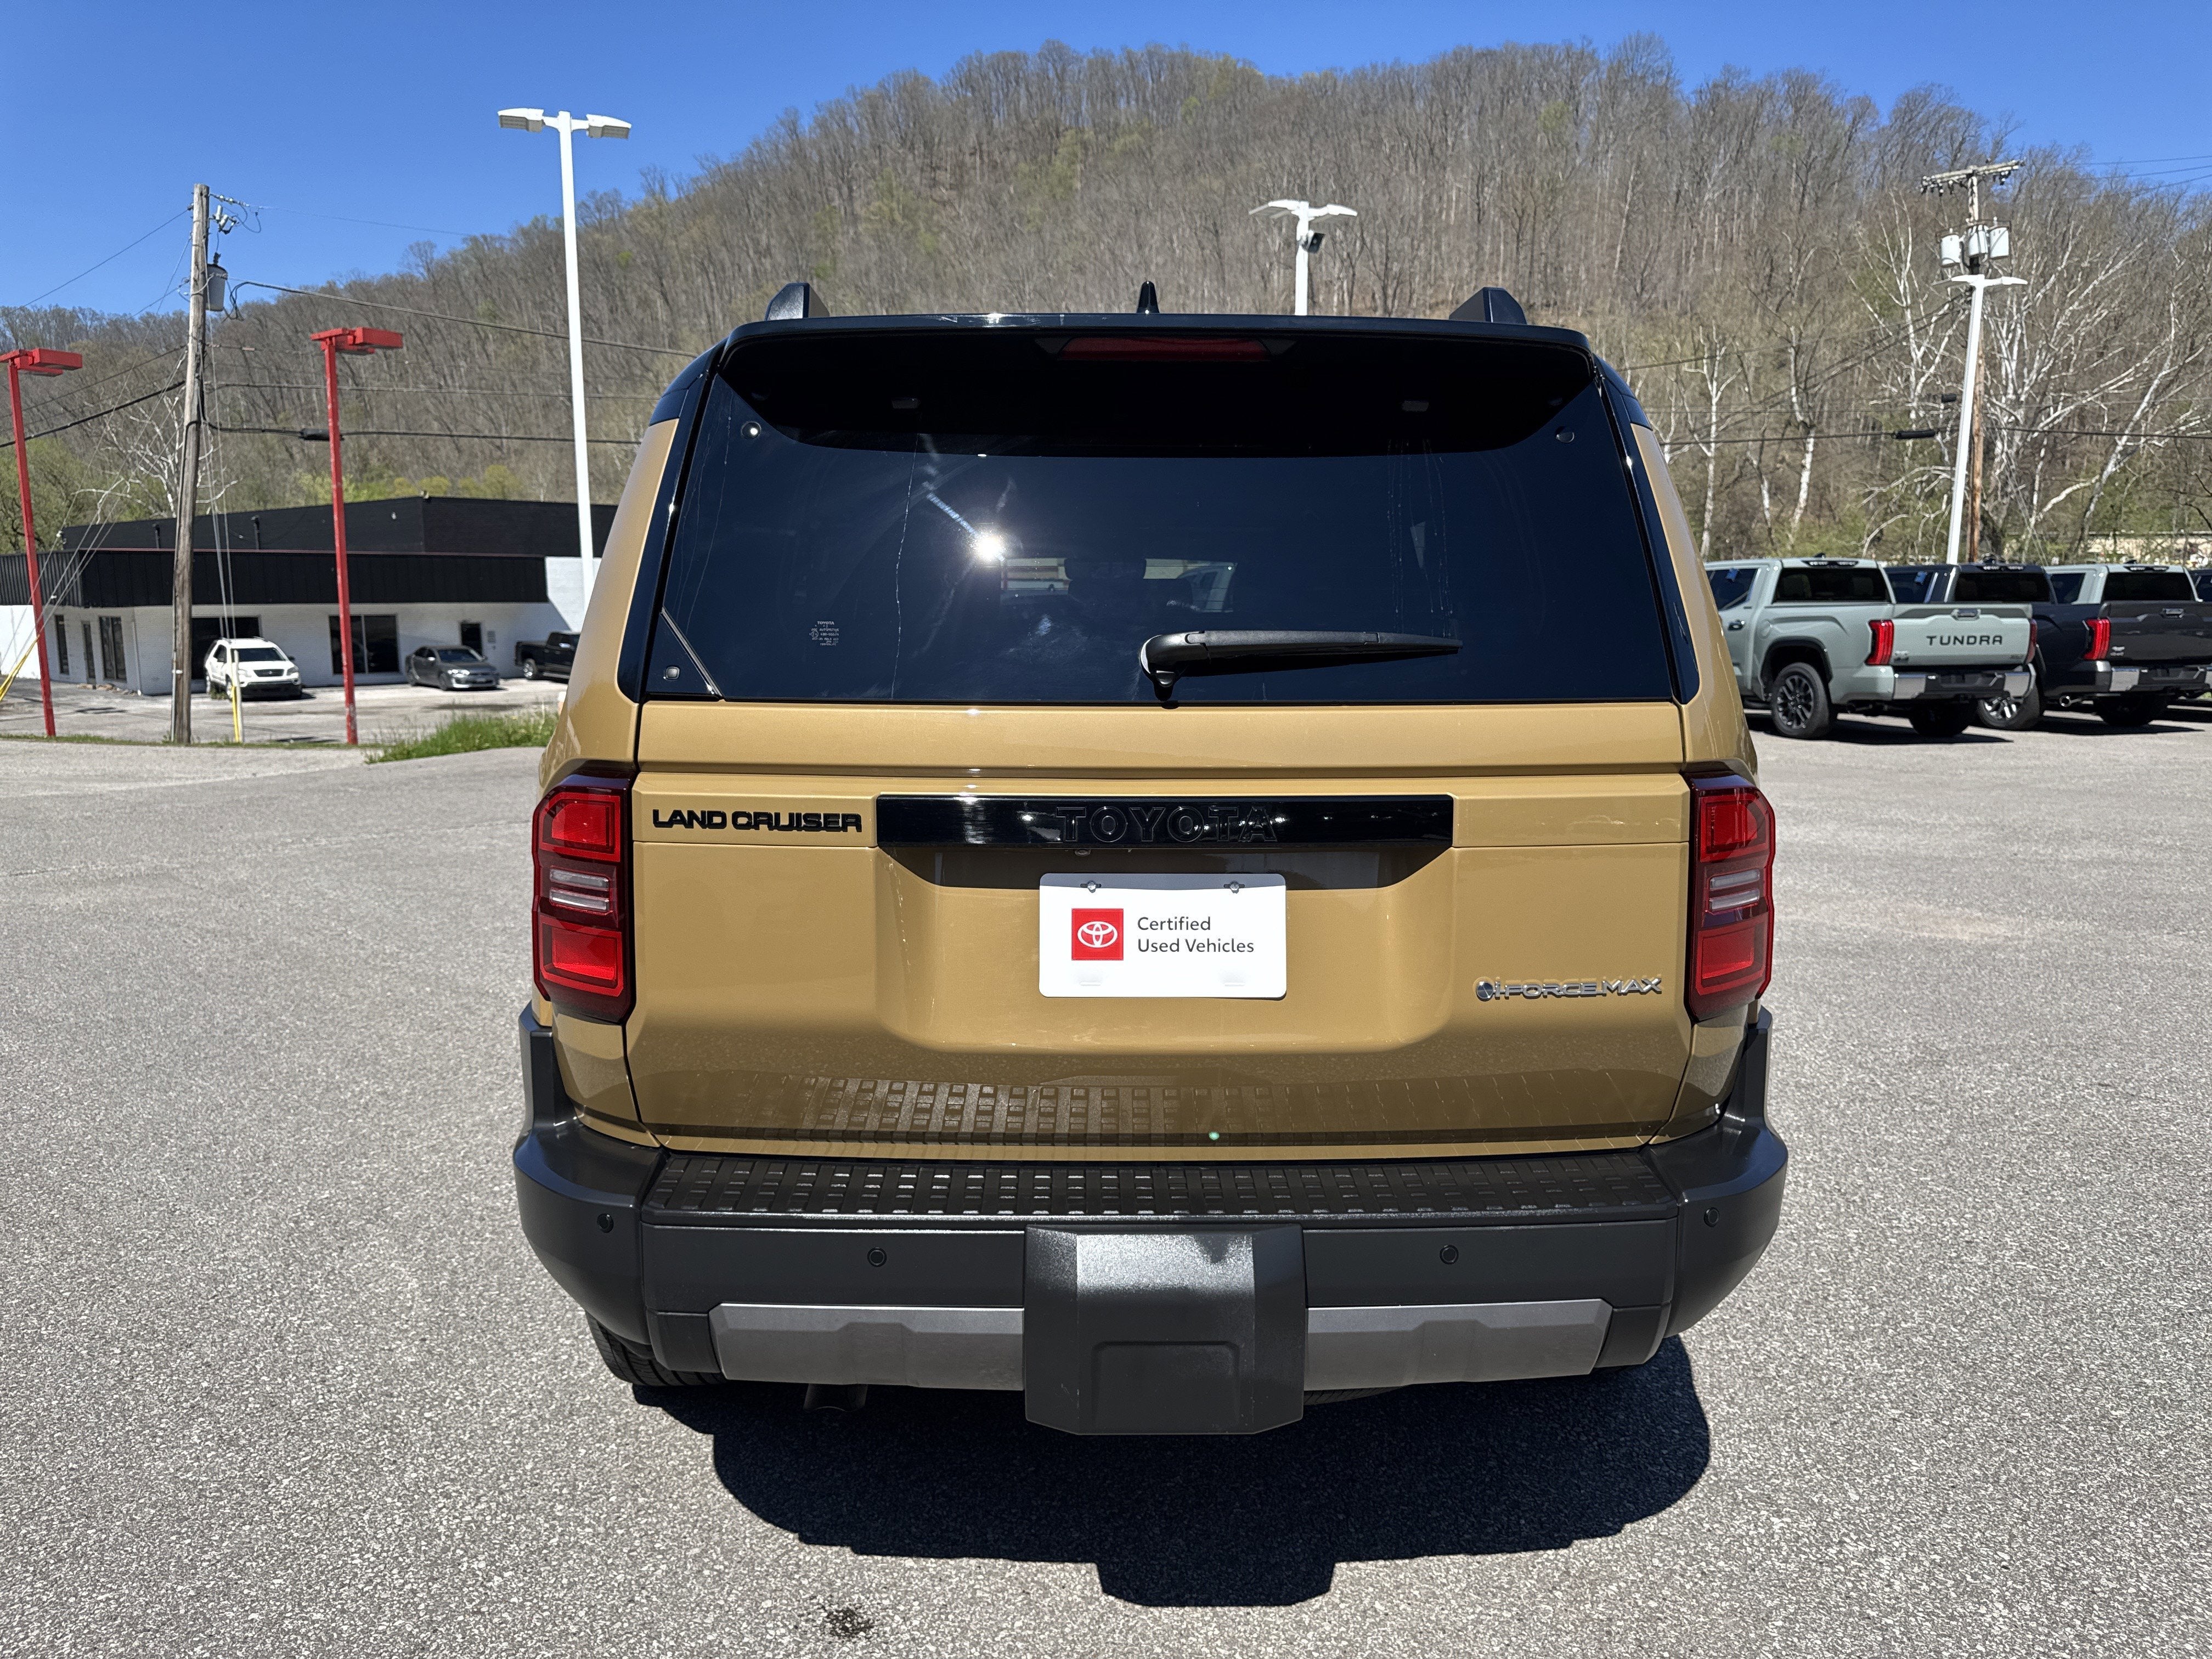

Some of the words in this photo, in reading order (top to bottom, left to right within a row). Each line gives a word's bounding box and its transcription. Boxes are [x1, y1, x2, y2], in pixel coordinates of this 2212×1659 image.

[1926, 635, 2003, 646] TUNDRA
[652, 809, 727, 830] LAND
[731, 810, 862, 832] CRUISER
[1056, 805, 1278, 843] TOYOTA
[1137, 916, 1211, 930] Certified
[1137, 938, 1180, 952] Used
[1185, 938, 1254, 952] Vehicles
[1602, 977, 1662, 996] MAX
